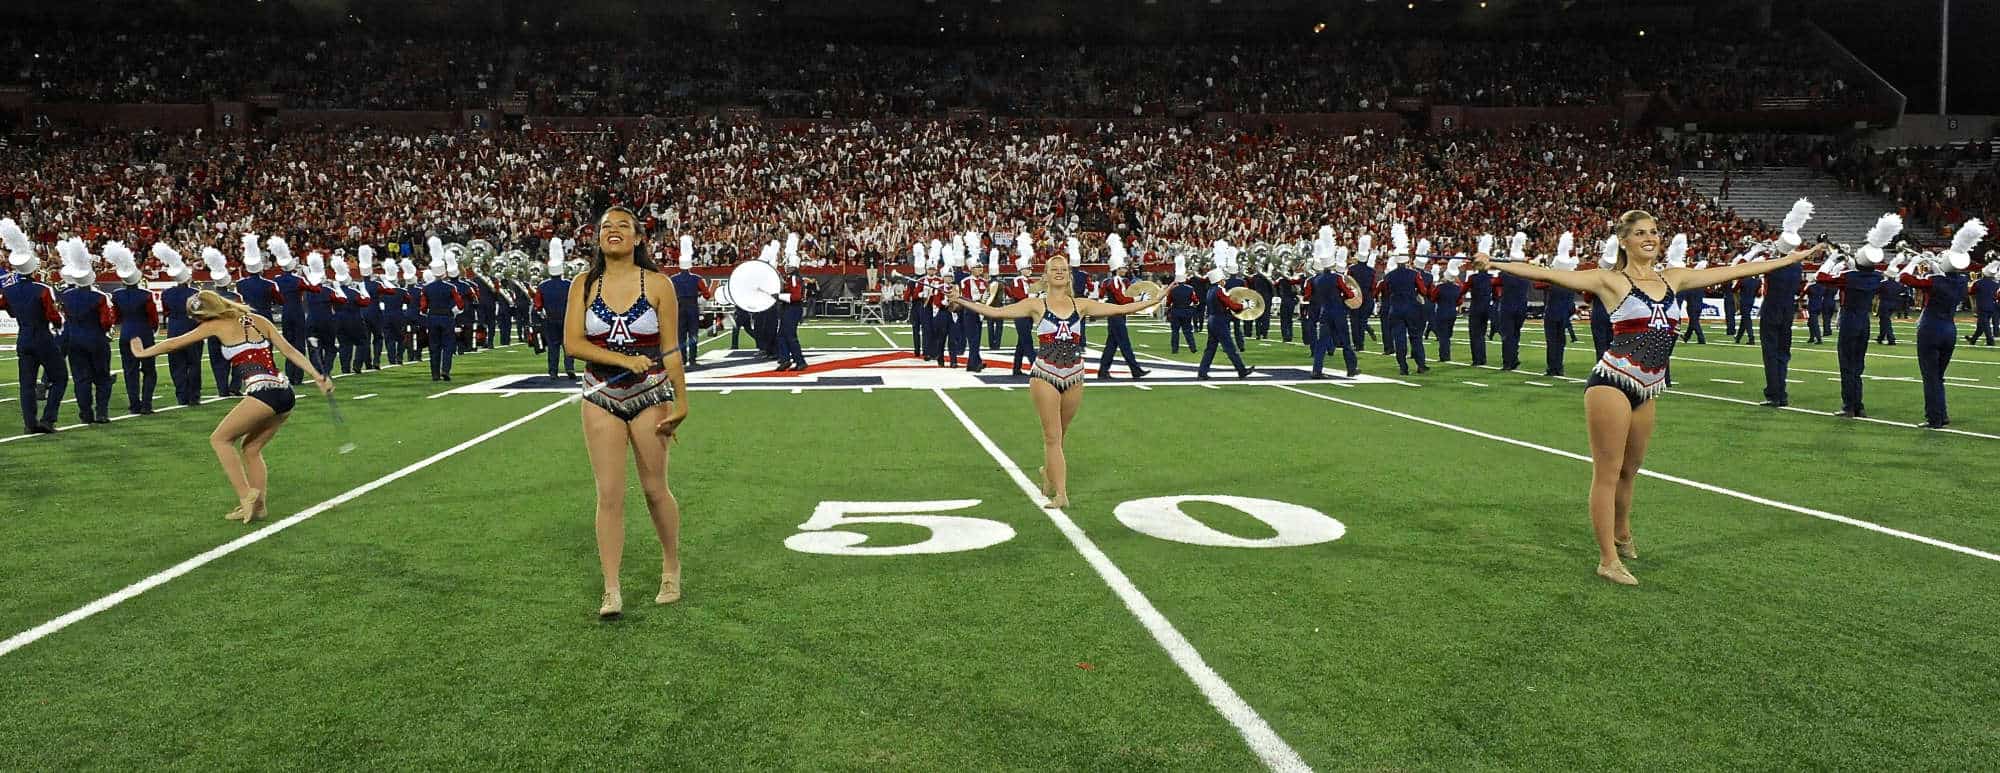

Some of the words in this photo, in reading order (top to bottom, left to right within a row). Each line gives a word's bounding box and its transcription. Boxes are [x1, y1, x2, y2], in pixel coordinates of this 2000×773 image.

[606, 316, 634, 345] A
[1647, 303, 1669, 330] A
[1054, 321, 1073, 341] A
[784, 498, 1017, 556] 5
[1112, 494, 1347, 548] 0
